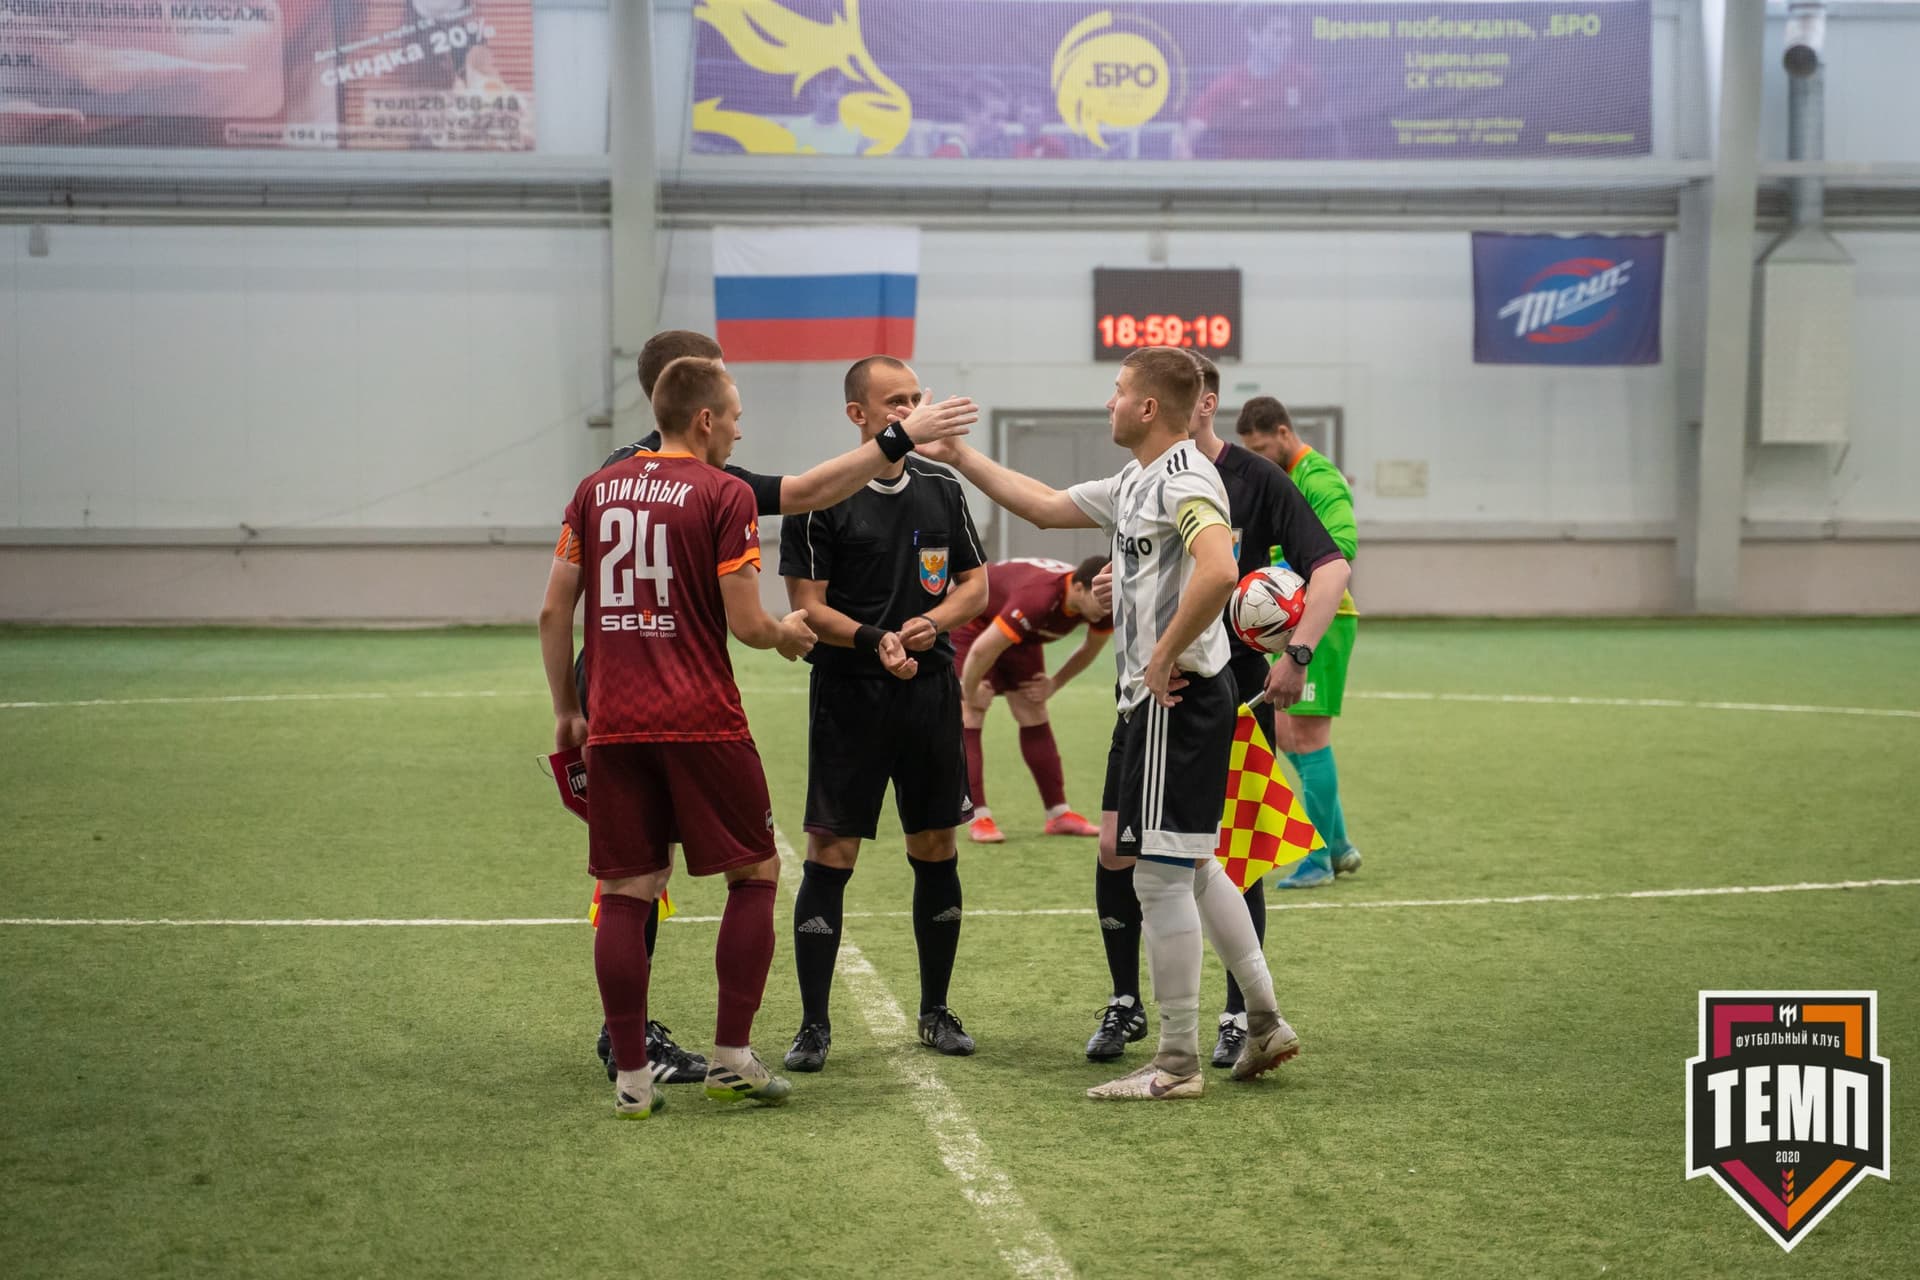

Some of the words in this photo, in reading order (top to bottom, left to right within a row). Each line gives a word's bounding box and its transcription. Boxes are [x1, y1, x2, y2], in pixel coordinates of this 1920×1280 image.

[1313, 16, 1389, 40] Время
[320, 43, 425, 86] скидка
[430, 17, 497, 54] 20%
[1085, 63, 1158, 89] .БРО
[1098, 313, 1231, 348] 18:59:19
[595, 473, 693, 507] ОЛИЙНЫК
[600, 507, 673, 607] 24
[601, 613, 675, 631] SEUS
